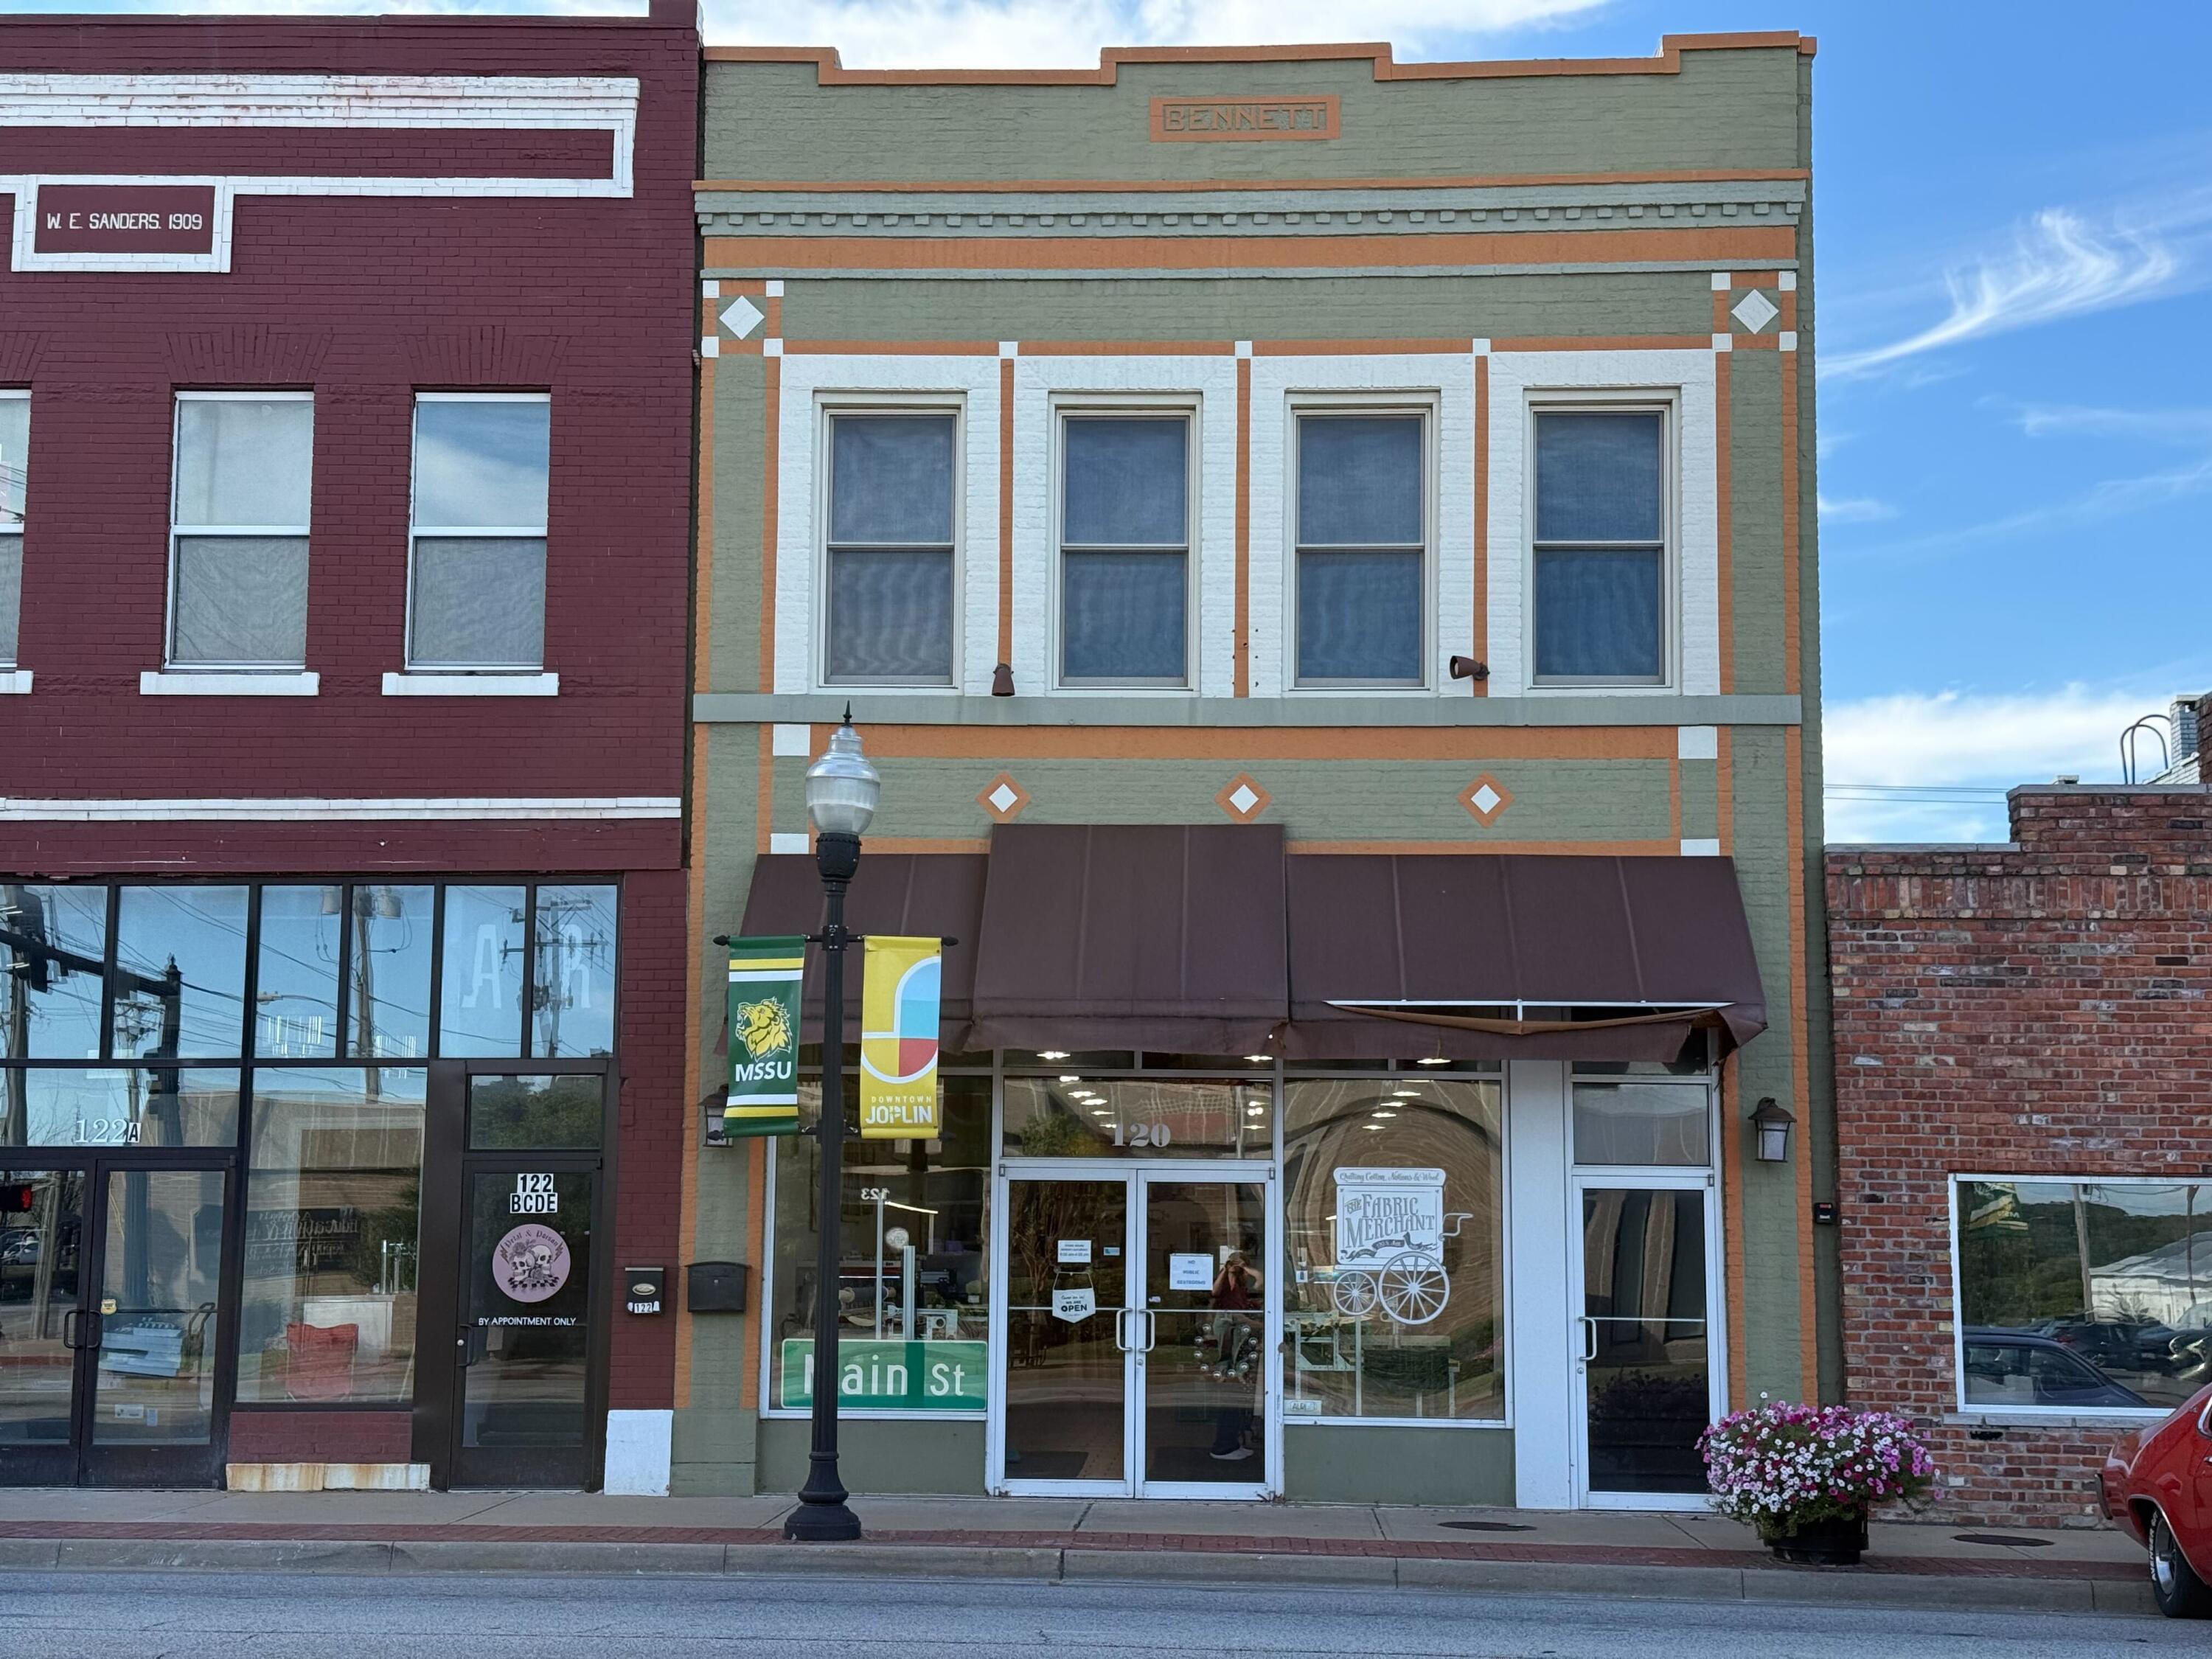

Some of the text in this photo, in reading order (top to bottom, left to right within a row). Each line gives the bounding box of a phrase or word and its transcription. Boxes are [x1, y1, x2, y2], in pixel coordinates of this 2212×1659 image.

[1164, 105, 1325, 131] BENNETT
[168, 214, 203, 229] 1909
[735, 1062, 792, 1082] MSSU
[865, 1105, 933, 1124] JOPLIN
[1112, 1121, 1171, 1147] 120
[520, 1174, 552, 1192] 122
[512, 1193, 556, 1212] BCDE
[1362, 1194, 1419, 1218] FABRIC
[1346, 1214, 1435, 1248] MERCHANT
[636, 1304, 651, 1312] 122
[1061, 1304, 1087, 1312] OPEN
[479, 1317, 576, 1326] BY APPOINTMENT ONLY
[930, 1363, 965, 1397] St
